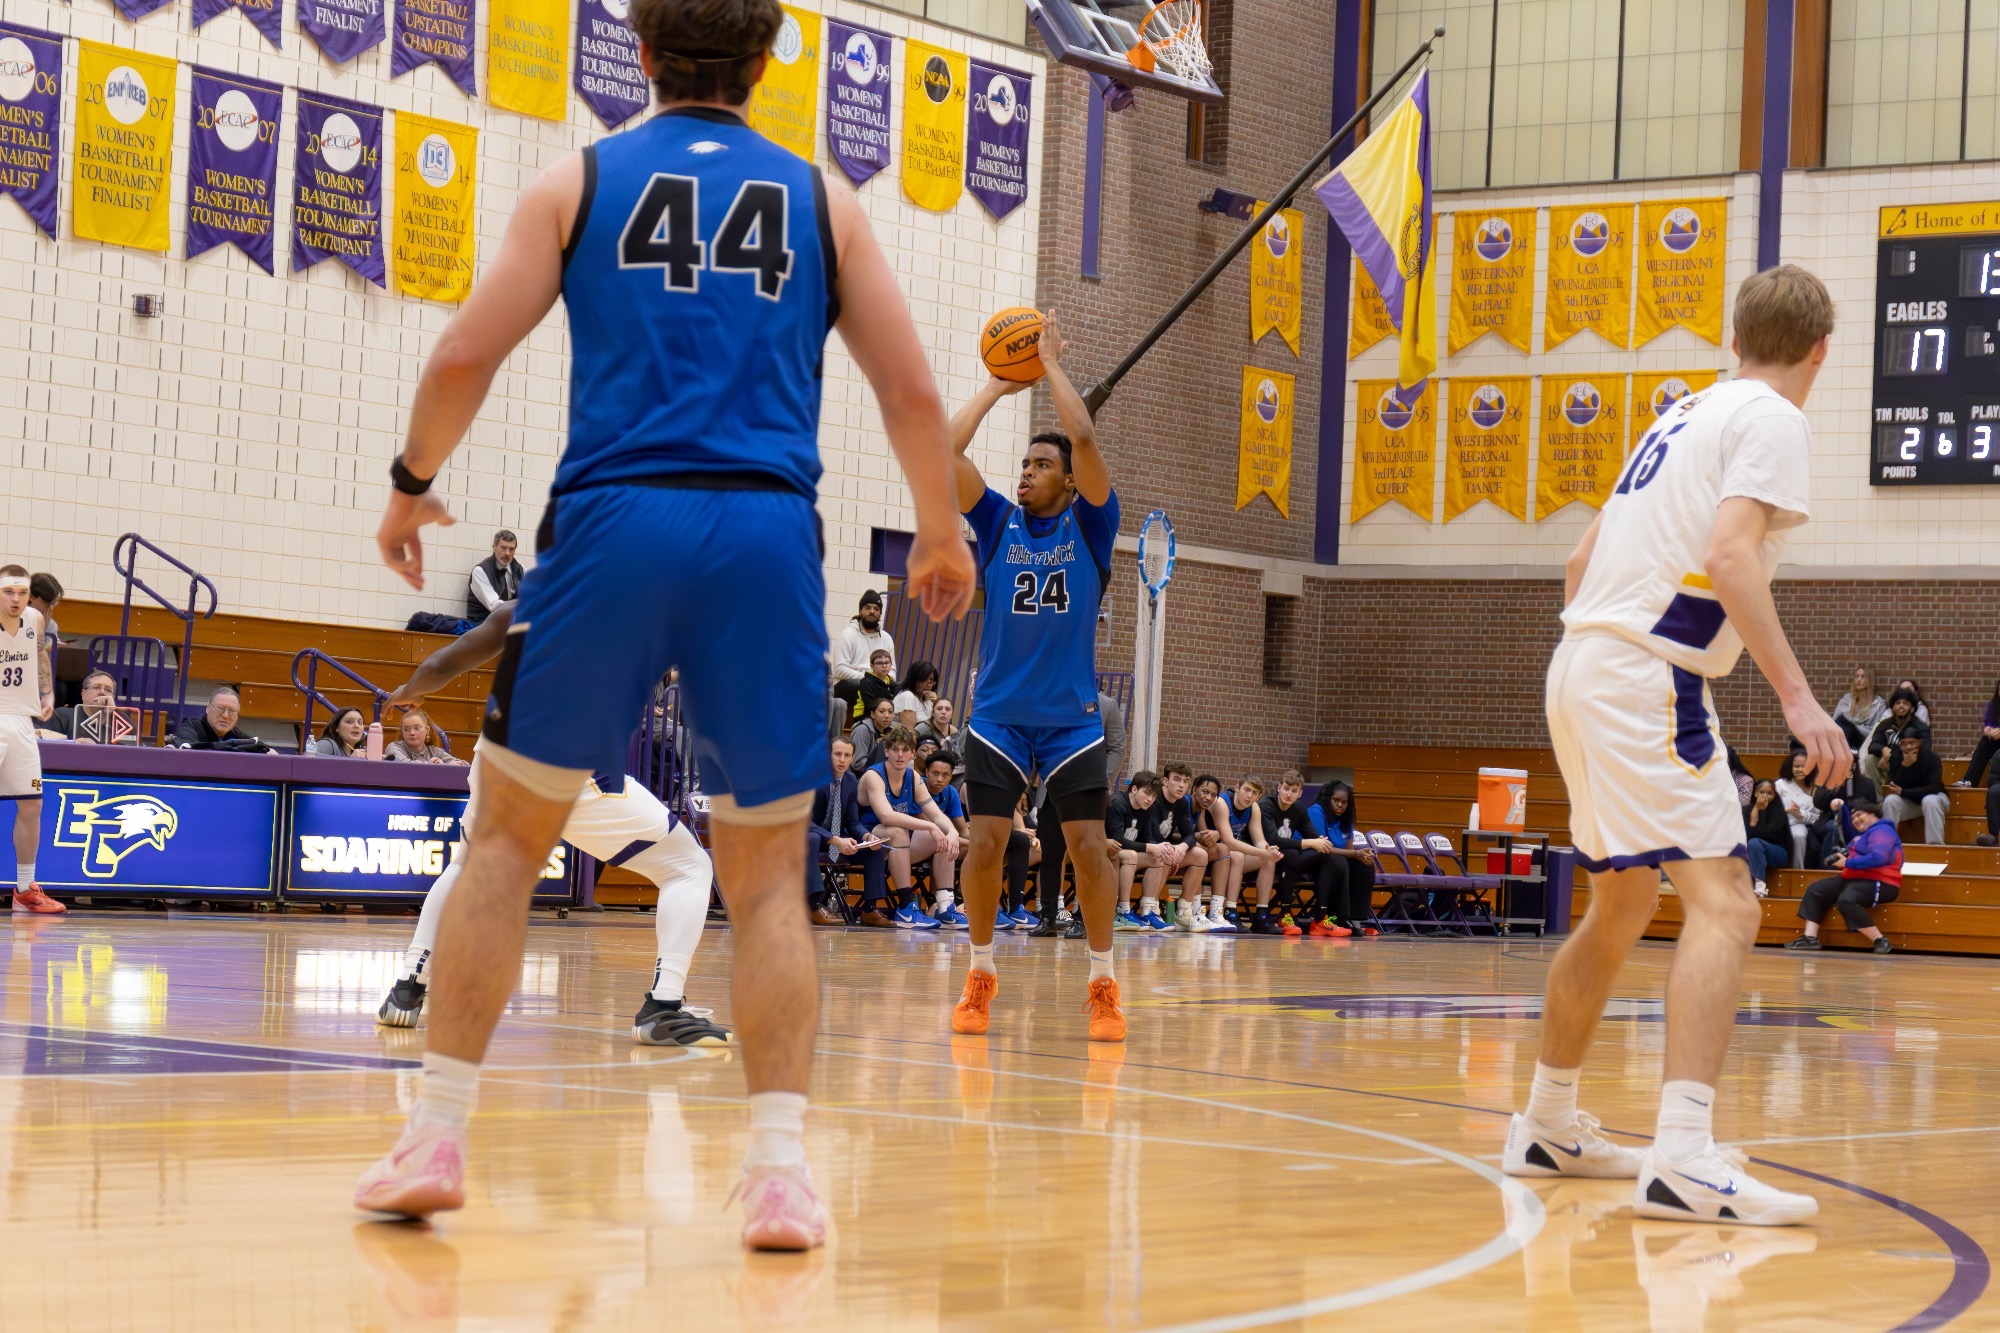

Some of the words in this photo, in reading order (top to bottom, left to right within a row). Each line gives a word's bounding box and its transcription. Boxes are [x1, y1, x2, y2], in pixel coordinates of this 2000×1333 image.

[315, 6, 365, 33] FINALIST
[405, 0, 468, 21] BASKETBALL
[504, 14, 554, 41] WOMEN'S
[402, 31, 468, 60] CHAMPIONS
[493, 32, 563, 64] BASKETBALL
[581, 35, 641, 64] BASKETBA
[830, 51, 845, 71] 19
[876, 63, 890, 83] 99
[35, 71, 57, 96] 06
[581, 74, 646, 103] SEMI-FINALIST
[910, 72, 922, 91] 19
[925, 69, 950, 88] NCAA
[953, 84, 966, 102] 99
[85, 82, 103, 105] 20
[150, 97, 168, 120] 07
[836, 83, 883, 108] WOMEN'S
[973, 92, 988, 113] 20
[1015, 103, 1029, 122] 00
[196, 105, 215, 129] 20
[221, 109, 252, 129] ECAC
[258, 119, 277, 144] 07
[753, 99, 813, 128] BASKETBALL
[831, 100, 889, 128] BASKETBALL
[0, 124, 51, 151] ETBALL
[96, 123, 156, 151] WOMEN'S
[830, 118, 890, 147] TOURNAMENT
[914, 123, 957, 146] WOMEN'S
[0, 145, 52, 171] NAMENT
[81, 142, 164, 173] BASKETBALL
[305, 131, 321, 155] 20
[361, 145, 378, 169] 14
[838, 139, 879, 161] FINALIST
[908, 138, 961, 166] BASKETBALL
[980, 139, 1020, 163] WOMEN'S
[400, 151, 415, 174] 20
[908, 155, 961, 182] TOURNAMENT
[975, 155, 1023, 180] BASKETBALL
[0, 167, 39, 190] ALIST
[79, 162, 163, 193] TOURNAMENT
[205, 168, 266, 195] WOMEN'S
[314, 167, 365, 195] WOMEN'S
[969, 172, 1026, 198] TOURNAMENT
[91, 185, 153, 212] FINALIST
[193, 185, 273, 217] BASKETBALL
[300, 185, 376, 216] BASKETBALL
[411, 190, 458, 214] WOMEN'S
[191, 205, 272, 235] TOURNAMENT
[401, 208, 466, 235] ASKETBALL
[1585, 215, 1600, 227] EC
[1675, 211, 1689, 222] EC
[1915, 211, 1963, 228] Home
[1971, 207, 1987, 226] of
[298, 227, 373, 257] PARTICIPANT
[617, 171, 795, 303] 44
[1461, 239, 1474, 256] 19
[1513, 236, 1528, 252] 94
[1555, 234, 1569, 251] 19
[1609, 231, 1625, 249] 95
[1646, 230, 1659, 247] 19
[1701, 226, 1717, 244] 95
[1461, 267, 1508, 280] WESTERN
[1509, 265, 1526, 279] NY
[1577, 262, 1600, 275] UCA
[1646, 258, 1697, 272] WESTERN
[1699, 256, 1715, 269] NY
[1467, 281, 1518, 296] REGIONAL
[1652, 273, 1707, 288] REGIONAL
[1483, 298, 1512, 311] PLACE
[1580, 293, 1609, 307] PLACE
[1654, 290, 1670, 305] 2nd
[1671, 290, 1704, 303] PLACE
[1473, 313, 1508, 327] DANCE
[1567, 309, 1604, 322] DANCE
[1657, 306, 1698, 320] DANCE
[1886, 300, 1948, 322] EAGLES
[1005, 331, 1040, 357] NCAA
[1910, 328, 1946, 372] 17
[1984, 342, 1995, 354] TO
[1362, 407, 1377, 424] 19
[1415, 406, 1430, 423] 95
[1454, 406, 1468, 424] 19
[1506, 405, 1523, 422] 96
[1547, 404, 1561, 421] 19
[1601, 402, 1617, 420] 96
[1636, 400, 1651, 417] 19
[1875, 408, 1892, 422] TM
[1894, 406, 1929, 421] FOULS
[1937, 412, 1956, 425] TOL
[1971, 405, 2000, 420] PLAY
[1384, 436, 1406, 448] UCA
[1454, 434, 1503, 447] WESTERN
[1504, 433, 1521, 446] NY
[1547, 433, 1597, 446] WESTERN
[1598, 431, 1616, 445] NY
[1900, 427, 1921, 460] 2
[1937, 432, 1953, 456] 6
[1972, 425, 1992, 459] 3
[1460, 450, 1512, 463] REGIONAL
[1553, 448, 1607, 461] REGIONAL
[1615, 421, 1688, 495] 15
[1387, 466, 1416, 479] PLACE
[1461, 466, 1476, 479] 2nd
[1477, 465, 1506, 478] PLACE
[1568, 464, 1598, 477] PLACE
[1882, 465, 1917, 479] POINTS
[1376, 482, 1409, 495] CHEER
[1466, 482, 1503, 494] DANCE
[1559, 480, 1595, 493] CHEER
[1011, 568, 1070, 615] 24
[0, 649, 29, 663] Elmira
[2, 666, 23, 687] 33
[387, 814, 430, 832] HOME
[433, 816, 454, 833] OF
[299, 834, 444, 876] SOARING
